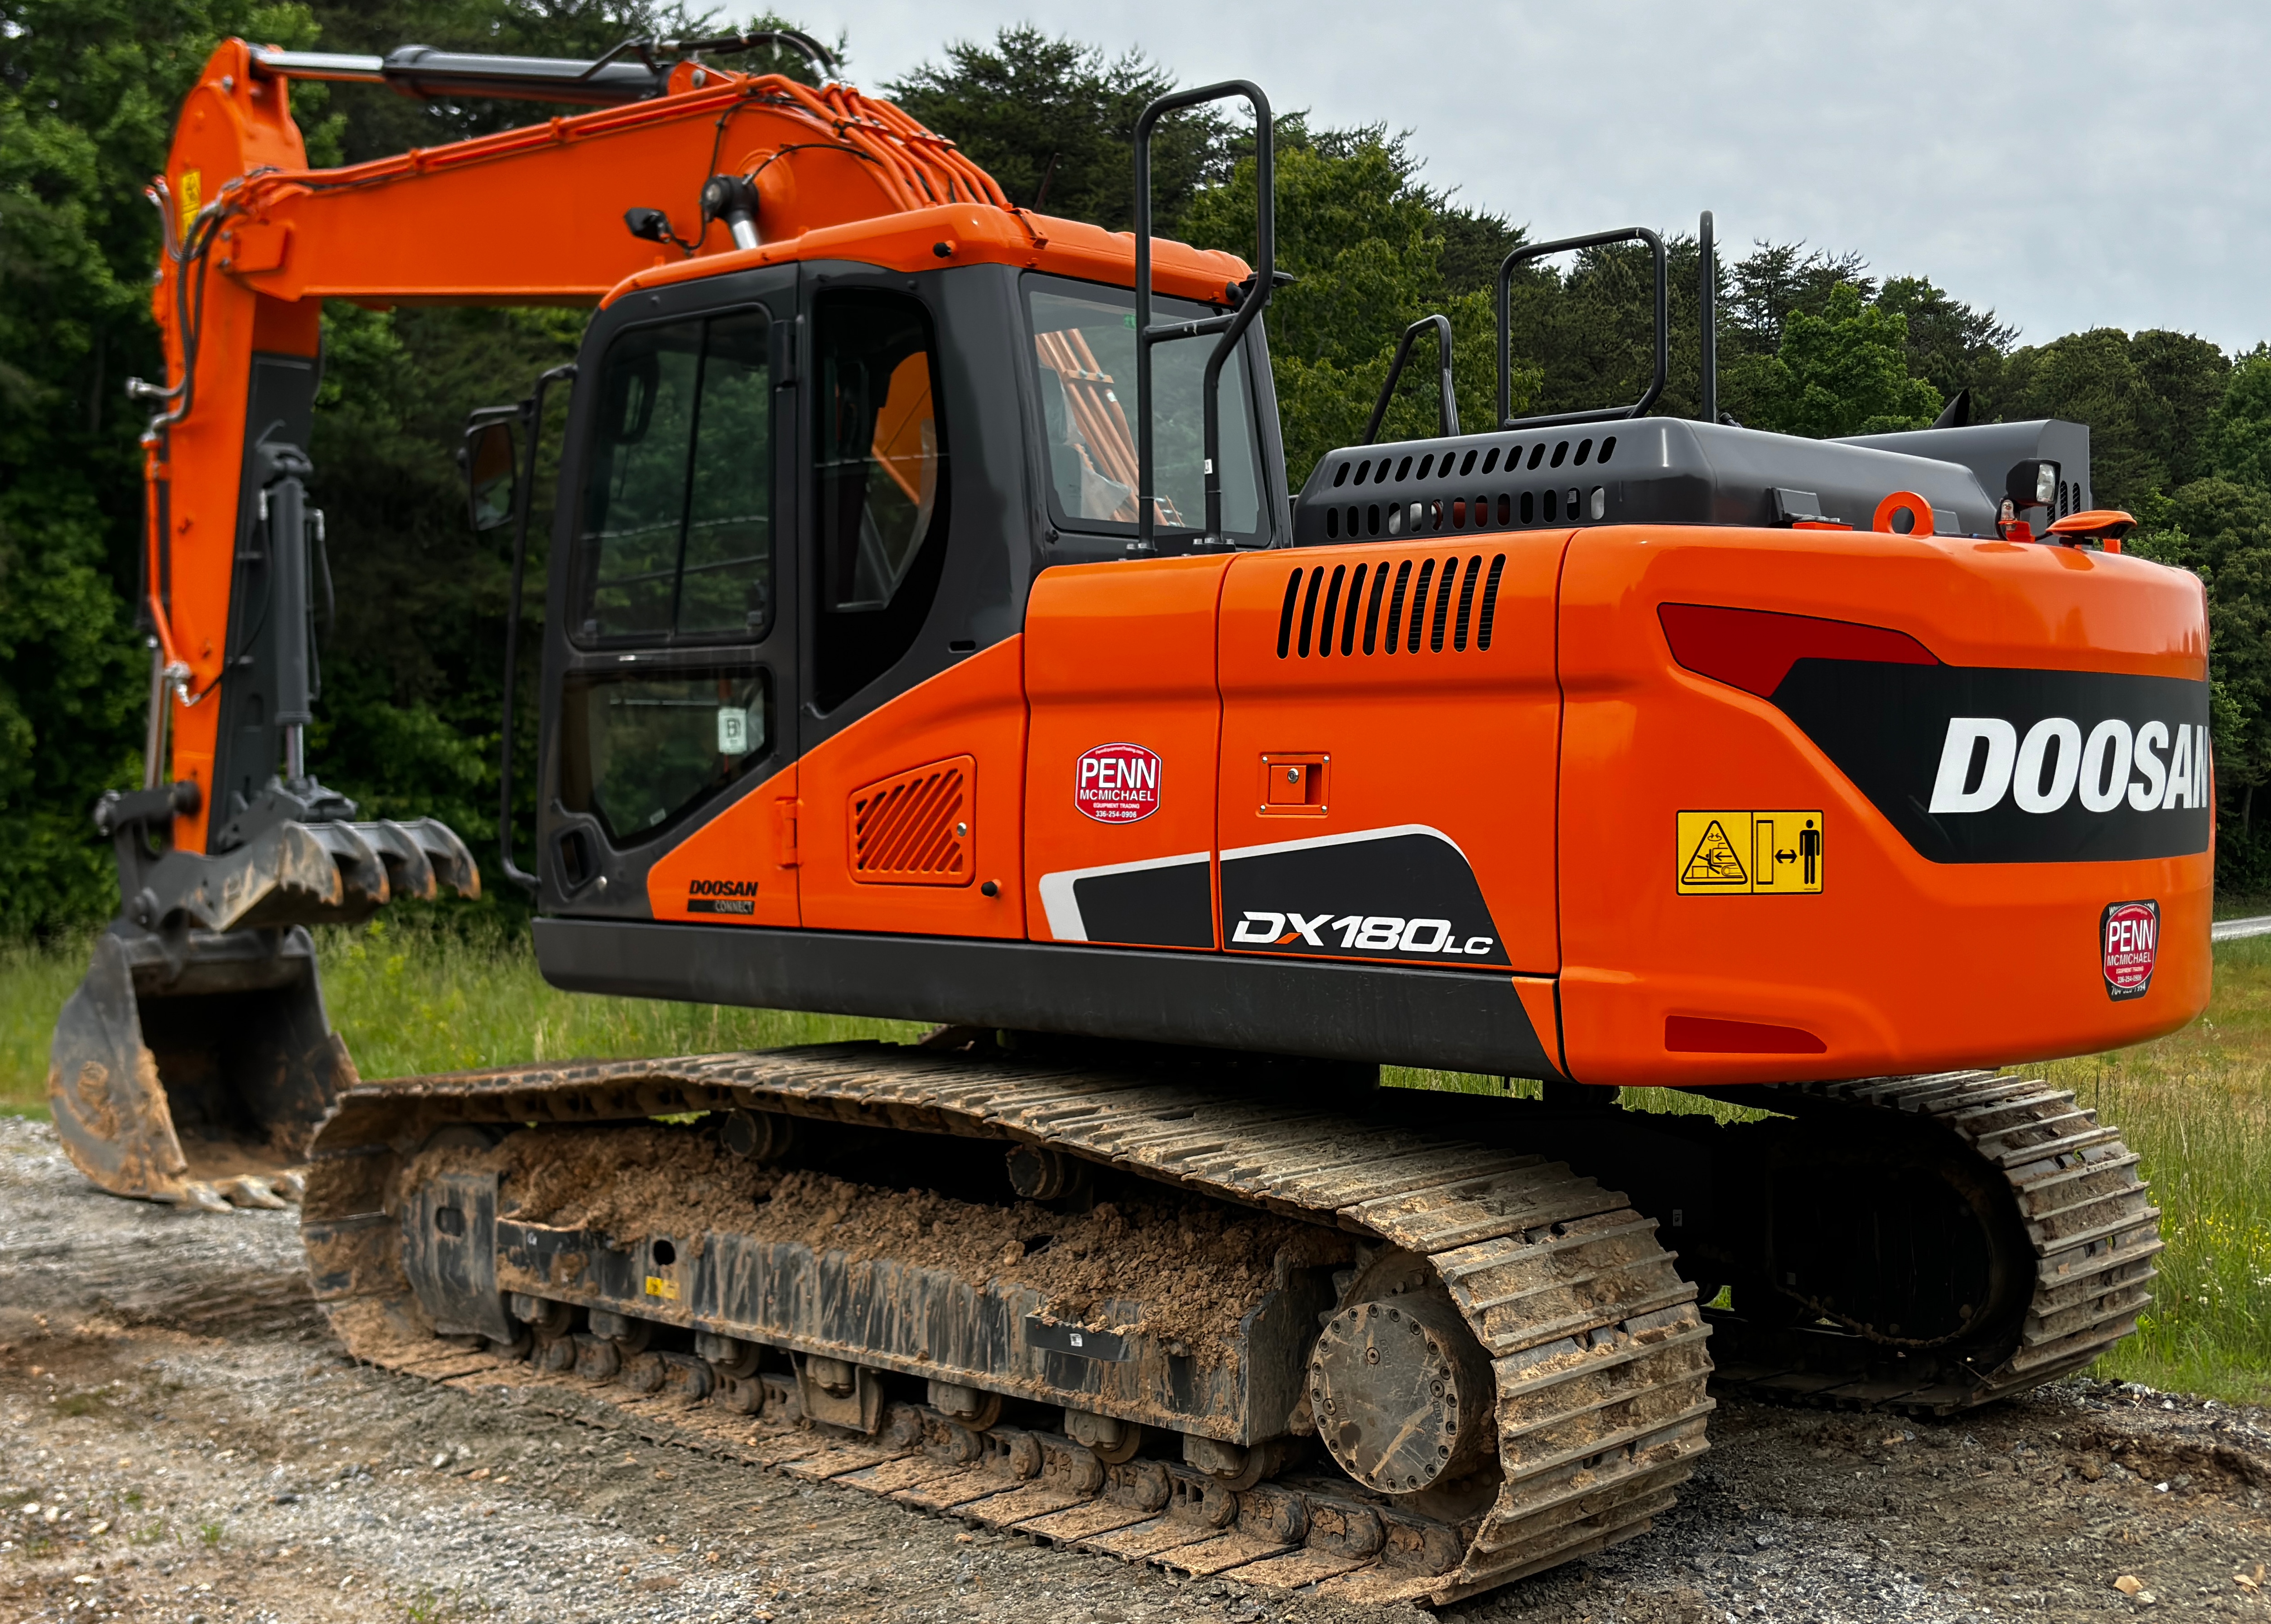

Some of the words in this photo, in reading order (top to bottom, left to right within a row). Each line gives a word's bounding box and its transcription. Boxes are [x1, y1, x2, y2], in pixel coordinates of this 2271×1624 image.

[1081, 758, 1156, 789] PENN
[1928, 718, 2208, 814] DOOSAN
[1080, 789, 1154, 801] MCMICHAEL
[689, 880, 759, 896] DOOSAN
[715, 899, 753, 913] CONNECT
[2108, 919, 2153, 953] PENN
[2107, 952, 2151, 966] MCMICHAEL
